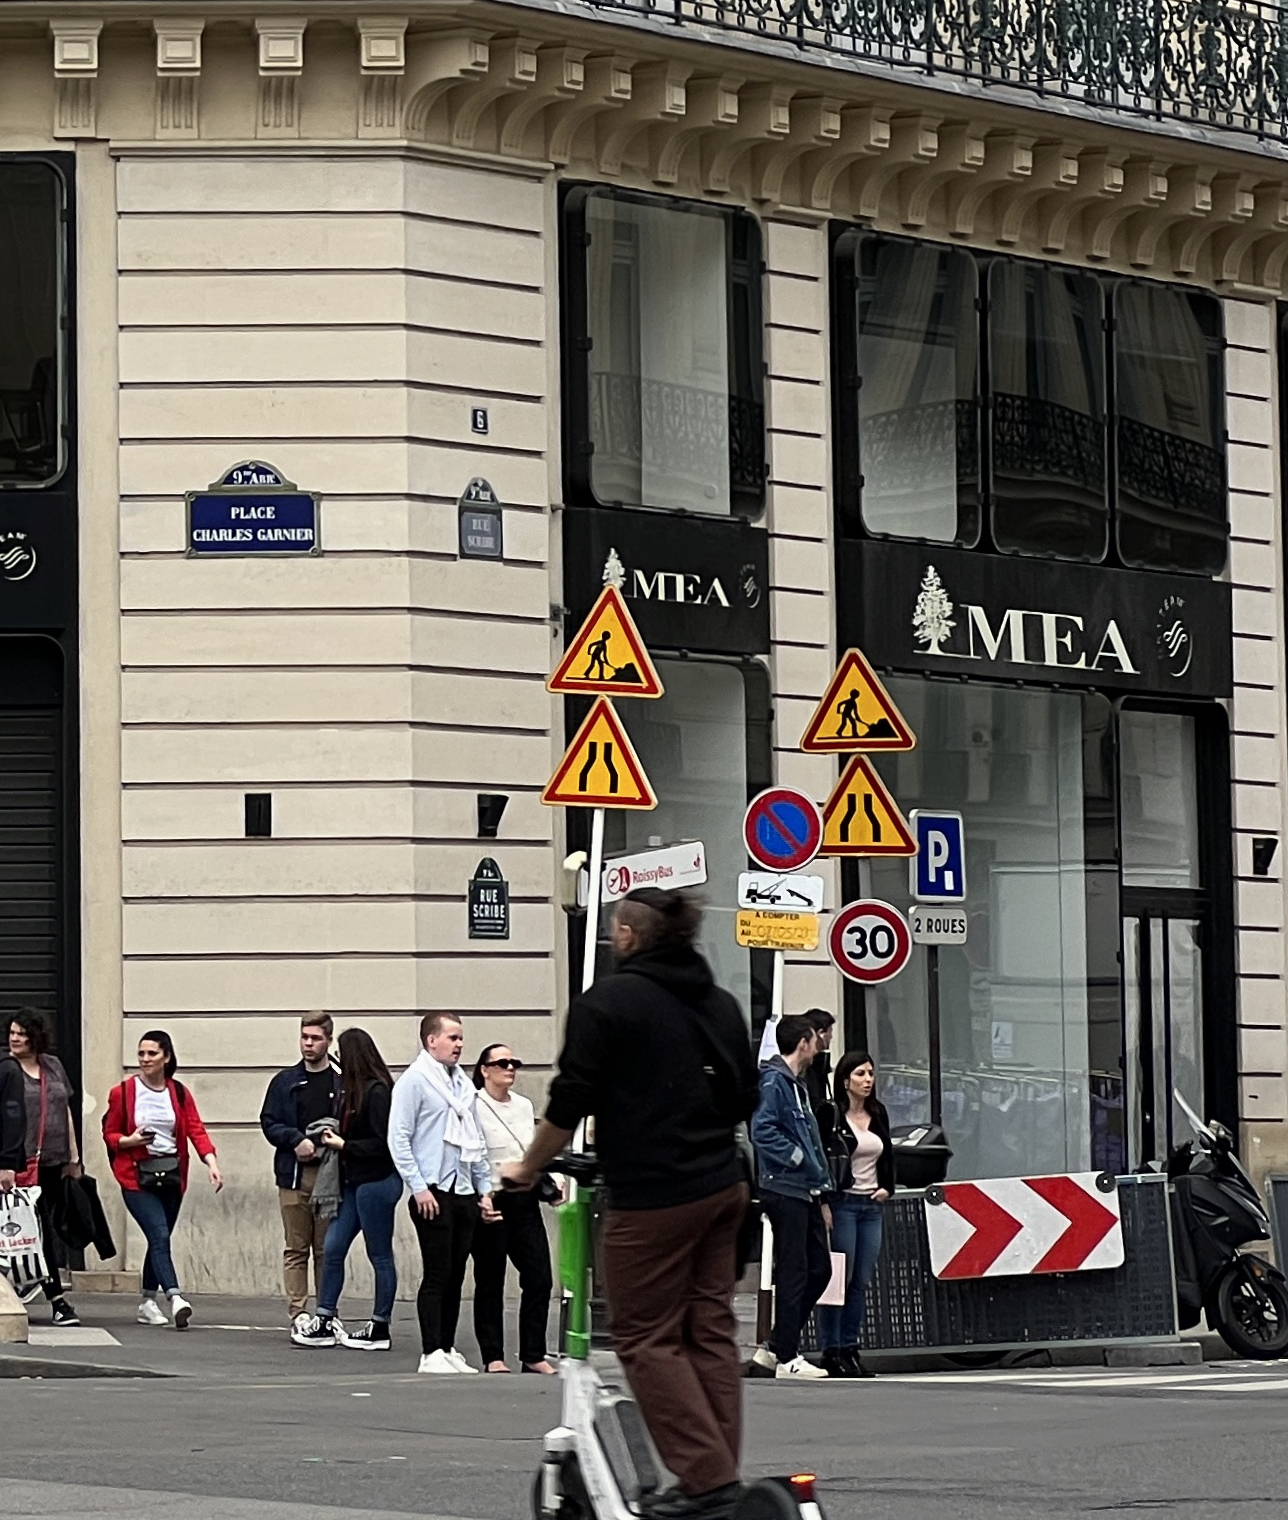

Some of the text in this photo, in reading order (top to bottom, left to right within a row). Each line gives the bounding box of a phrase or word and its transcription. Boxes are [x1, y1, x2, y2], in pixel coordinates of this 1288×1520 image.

[476, 410, 484, 429] 6
[230, 506, 276, 519] PLACE
[192, 528, 313, 541] CHARLES GARNIER
[630, 569, 733, 607] MEA
[959, 603, 1141, 674] MEA
[927, 830, 950, 883] P
[632, 865, 674, 884] RoissyBus
[480, 889, 498, 903] RUE
[473, 904, 505, 918] SCRIBE
[763, 912, 800, 920] COMPTER
[914, 917, 965, 934] 2 ROUES
[846, 925, 895, 960] 30
